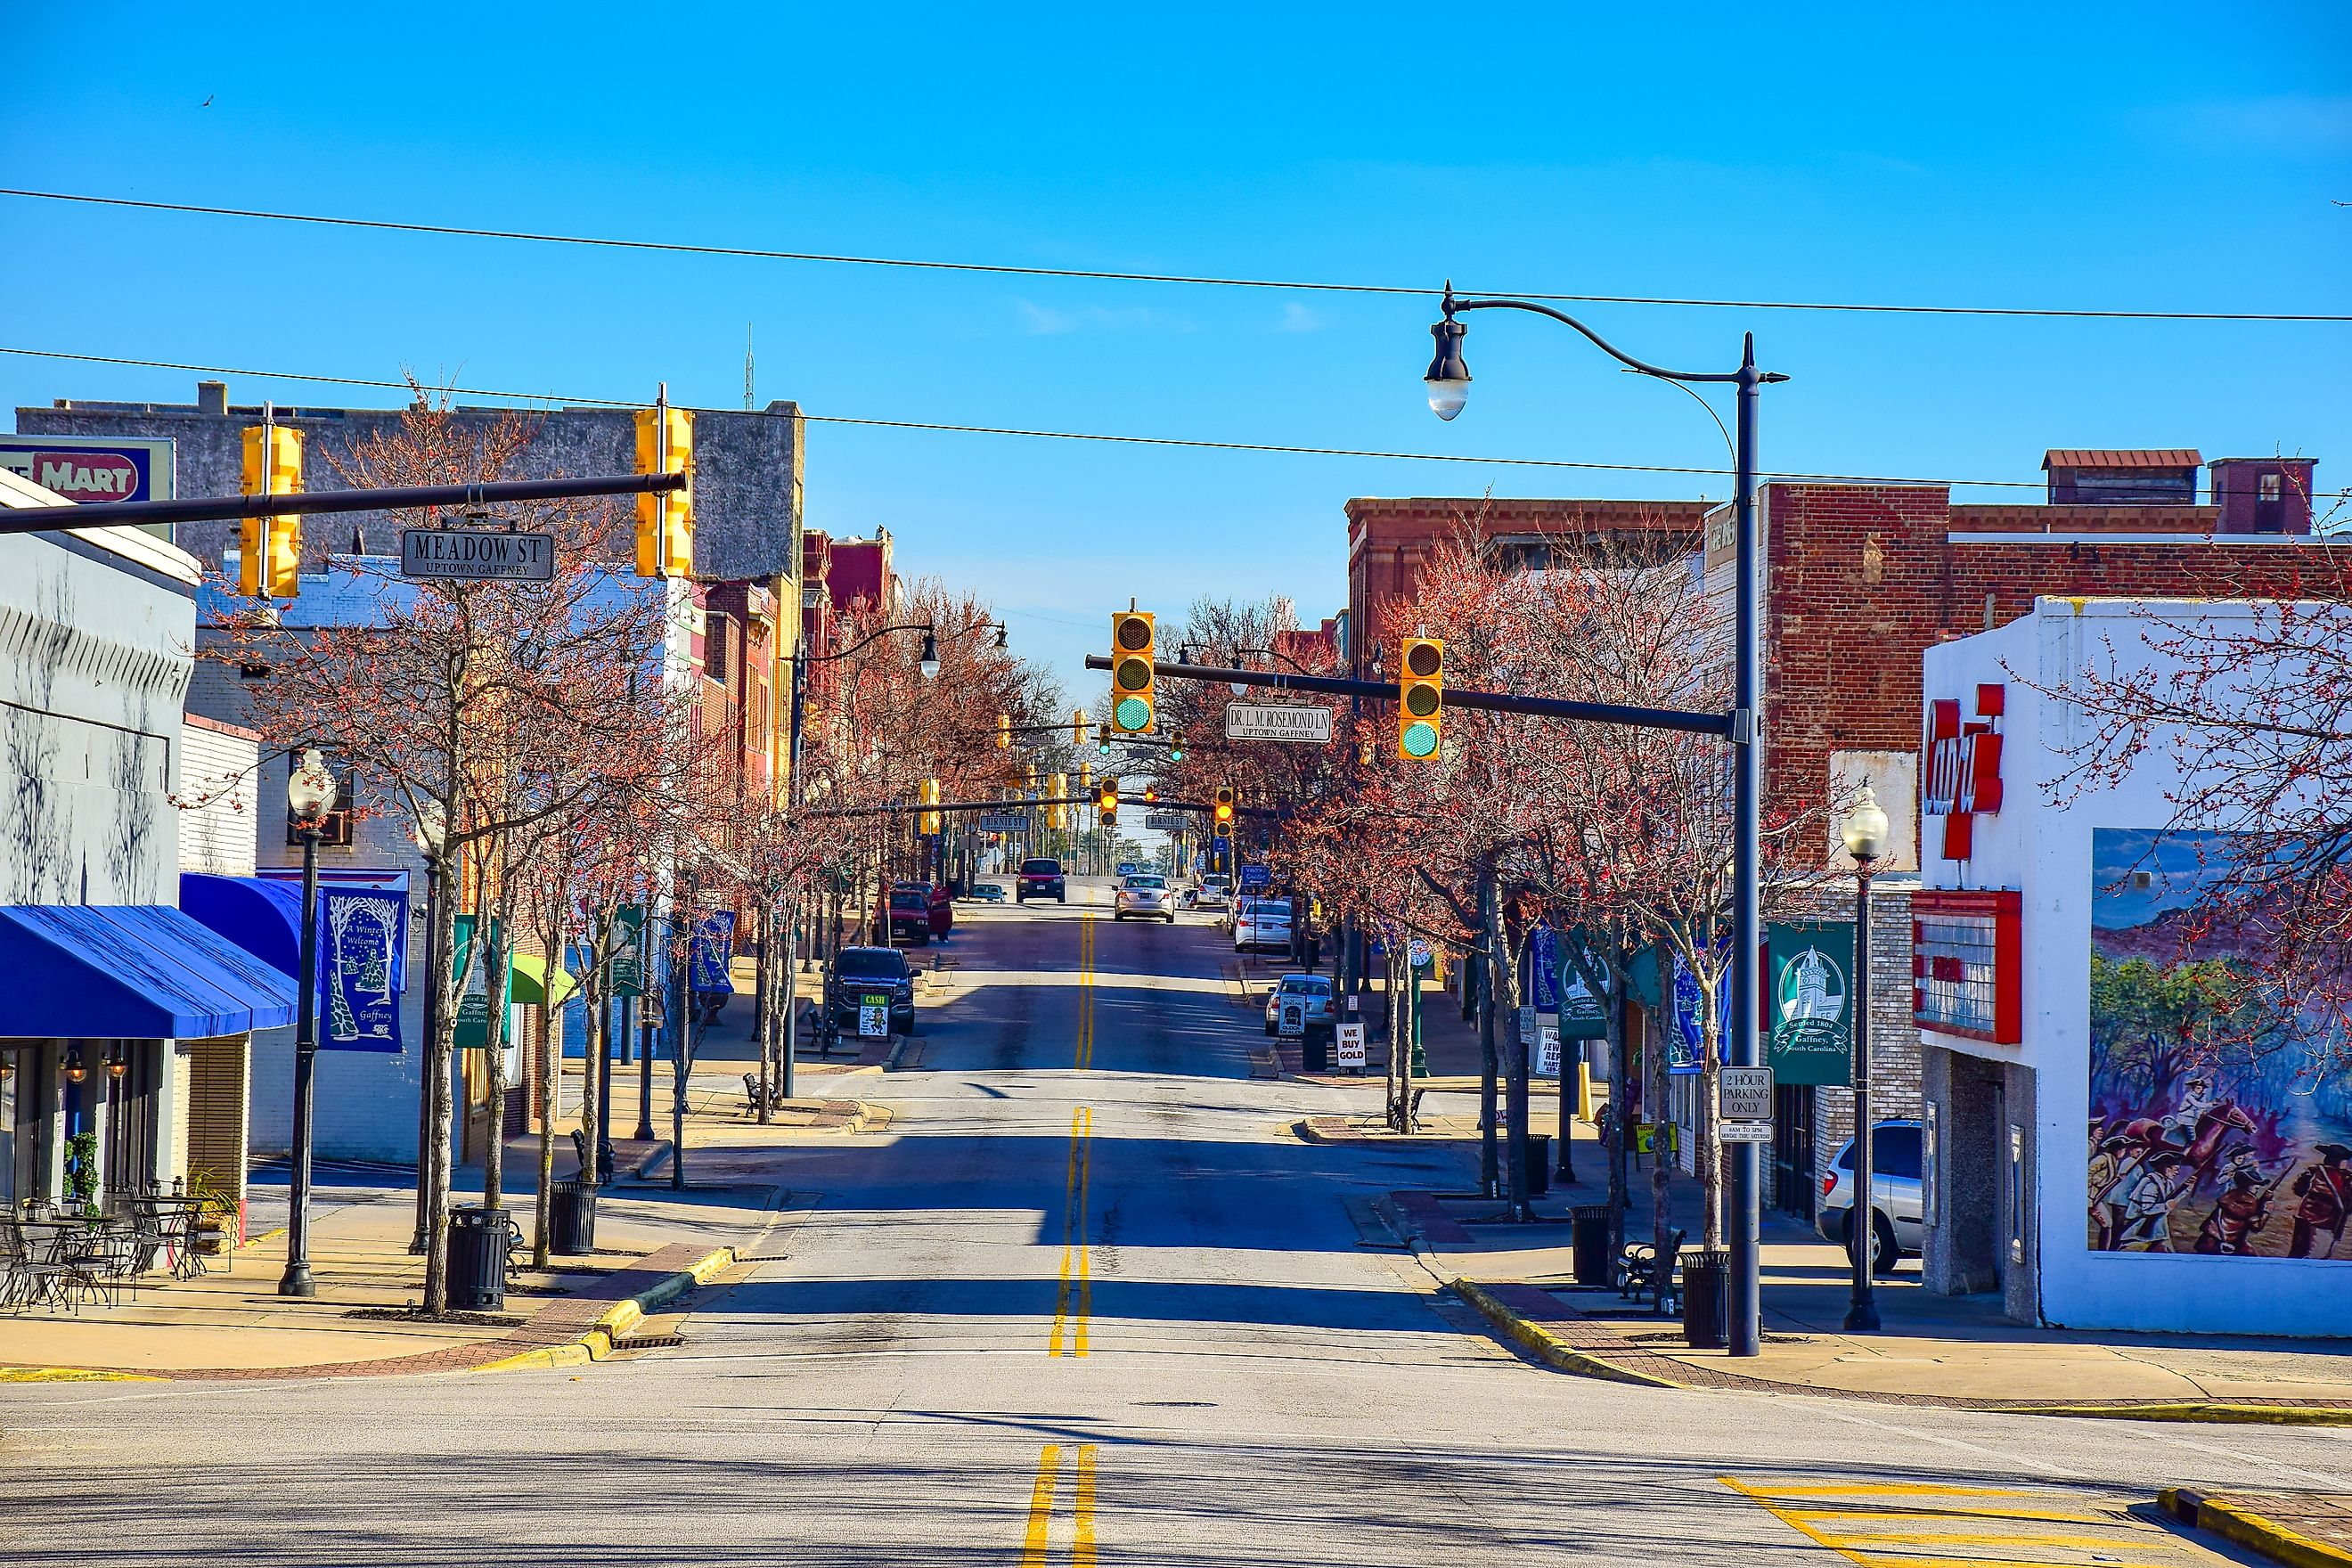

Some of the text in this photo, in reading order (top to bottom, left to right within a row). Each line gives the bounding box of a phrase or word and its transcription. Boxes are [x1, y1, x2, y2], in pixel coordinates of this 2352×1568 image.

[42, 461, 131, 493] MART
[414, 535, 542, 563] MEADOW ST
[426, 562, 529, 576] UPTOWN GAFFNEY
[1230, 709, 1328, 729] DR. L. M. ROSEMOND LN
[1243, 728, 1315, 738] UPTOWN GAFFNEY
[986, 817, 1024, 826] BIRNIE ST
[1150, 816, 1183, 825] BIRNIE ST
[355, 925, 384, 935] Winter
[347, 936, 380, 945] Welcome
[865, 995, 886, 1004] CASH
[359, 1010, 392, 1023] Gaffney
[461, 1009, 488, 1017] Gaffney
[1789, 1019, 1833, 1029] Settled 1804
[1343, 1029, 1358, 1037] WE
[1342, 1041, 1360, 1049] BUY
[1795, 1035, 1828, 1045] Gaffney,
[1340, 1051, 1364, 1059] GOLD
[1727, 1074, 1765, 1086] 2 HOUR
[1724, 1088, 1768, 1099] PARKING
[1732, 1102, 1760, 1113] ONLY
